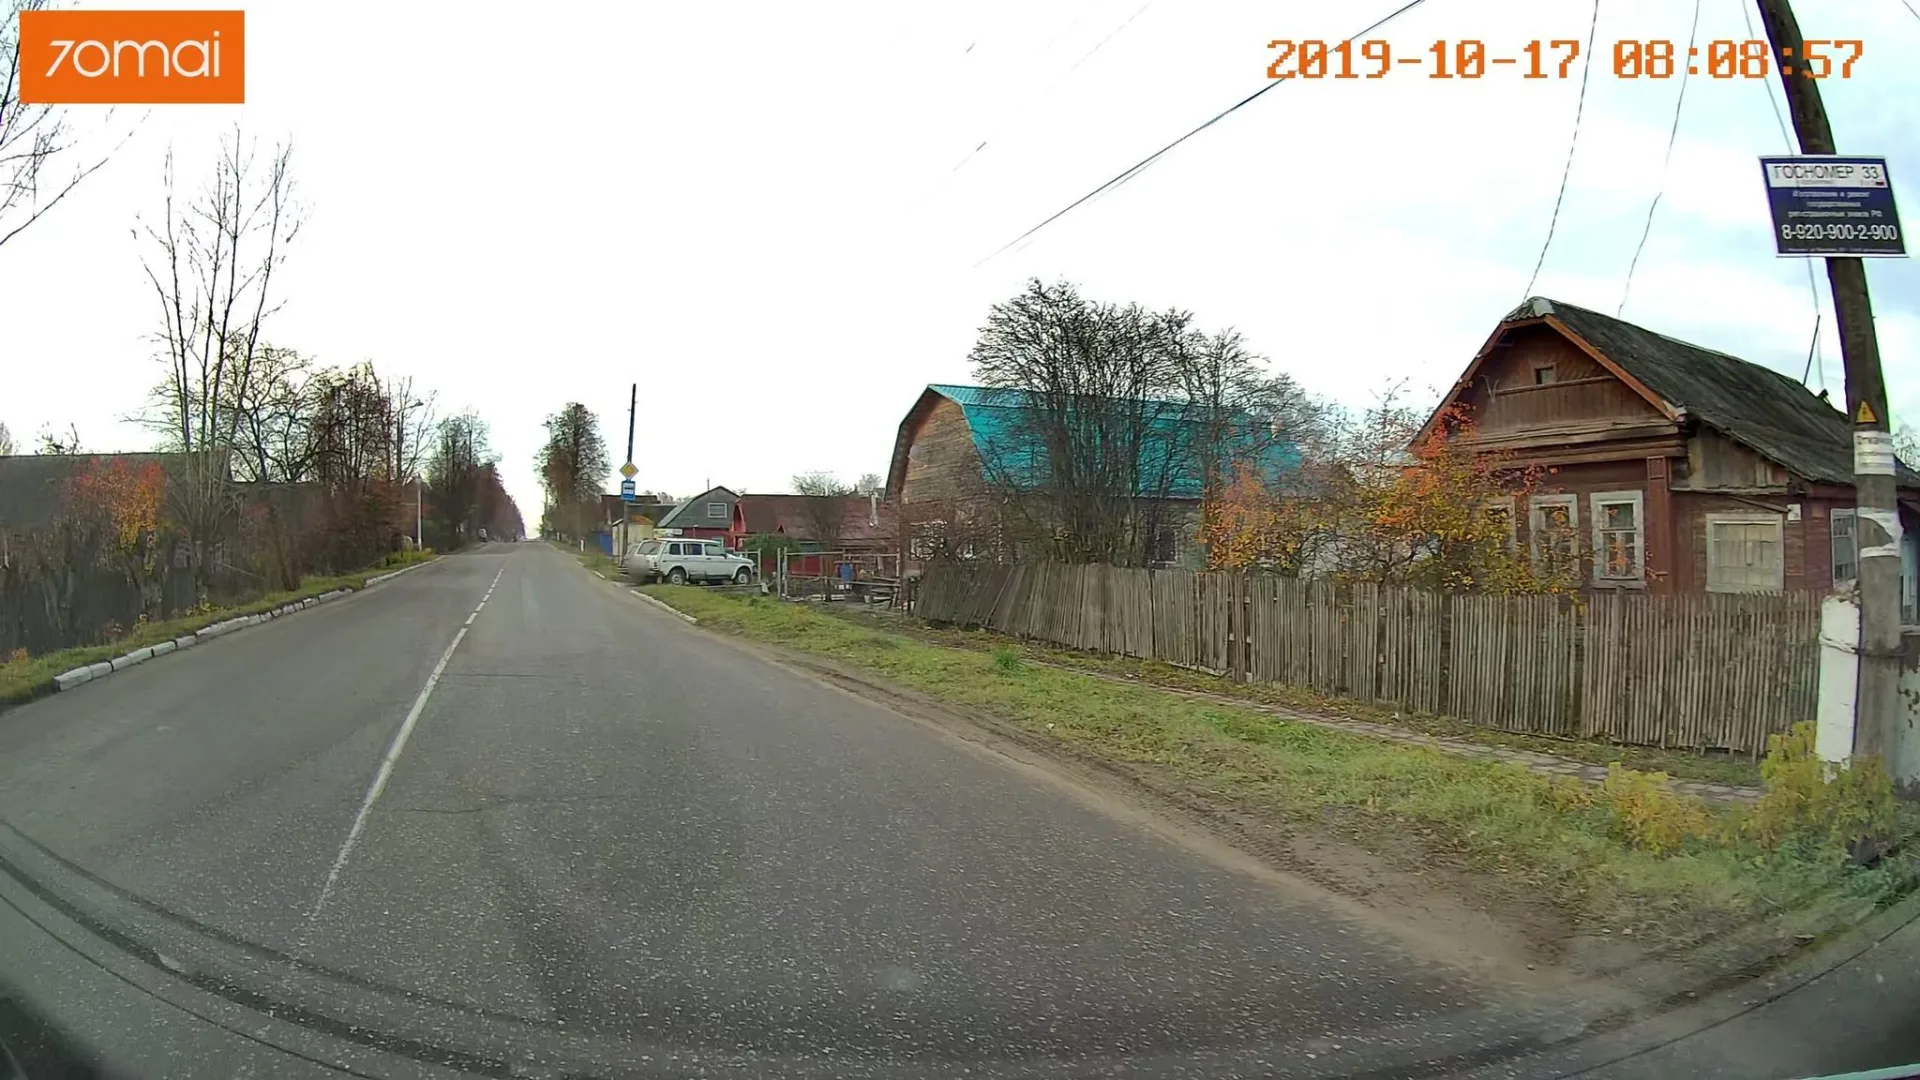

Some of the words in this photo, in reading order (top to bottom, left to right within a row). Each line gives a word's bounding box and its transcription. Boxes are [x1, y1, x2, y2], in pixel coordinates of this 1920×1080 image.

[1774, 165, 1853, 179] ГОСНОМЕР
[1861, 166, 1879, 179] 33
[1781, 224, 1898, 240] 8-920-900-2-900
